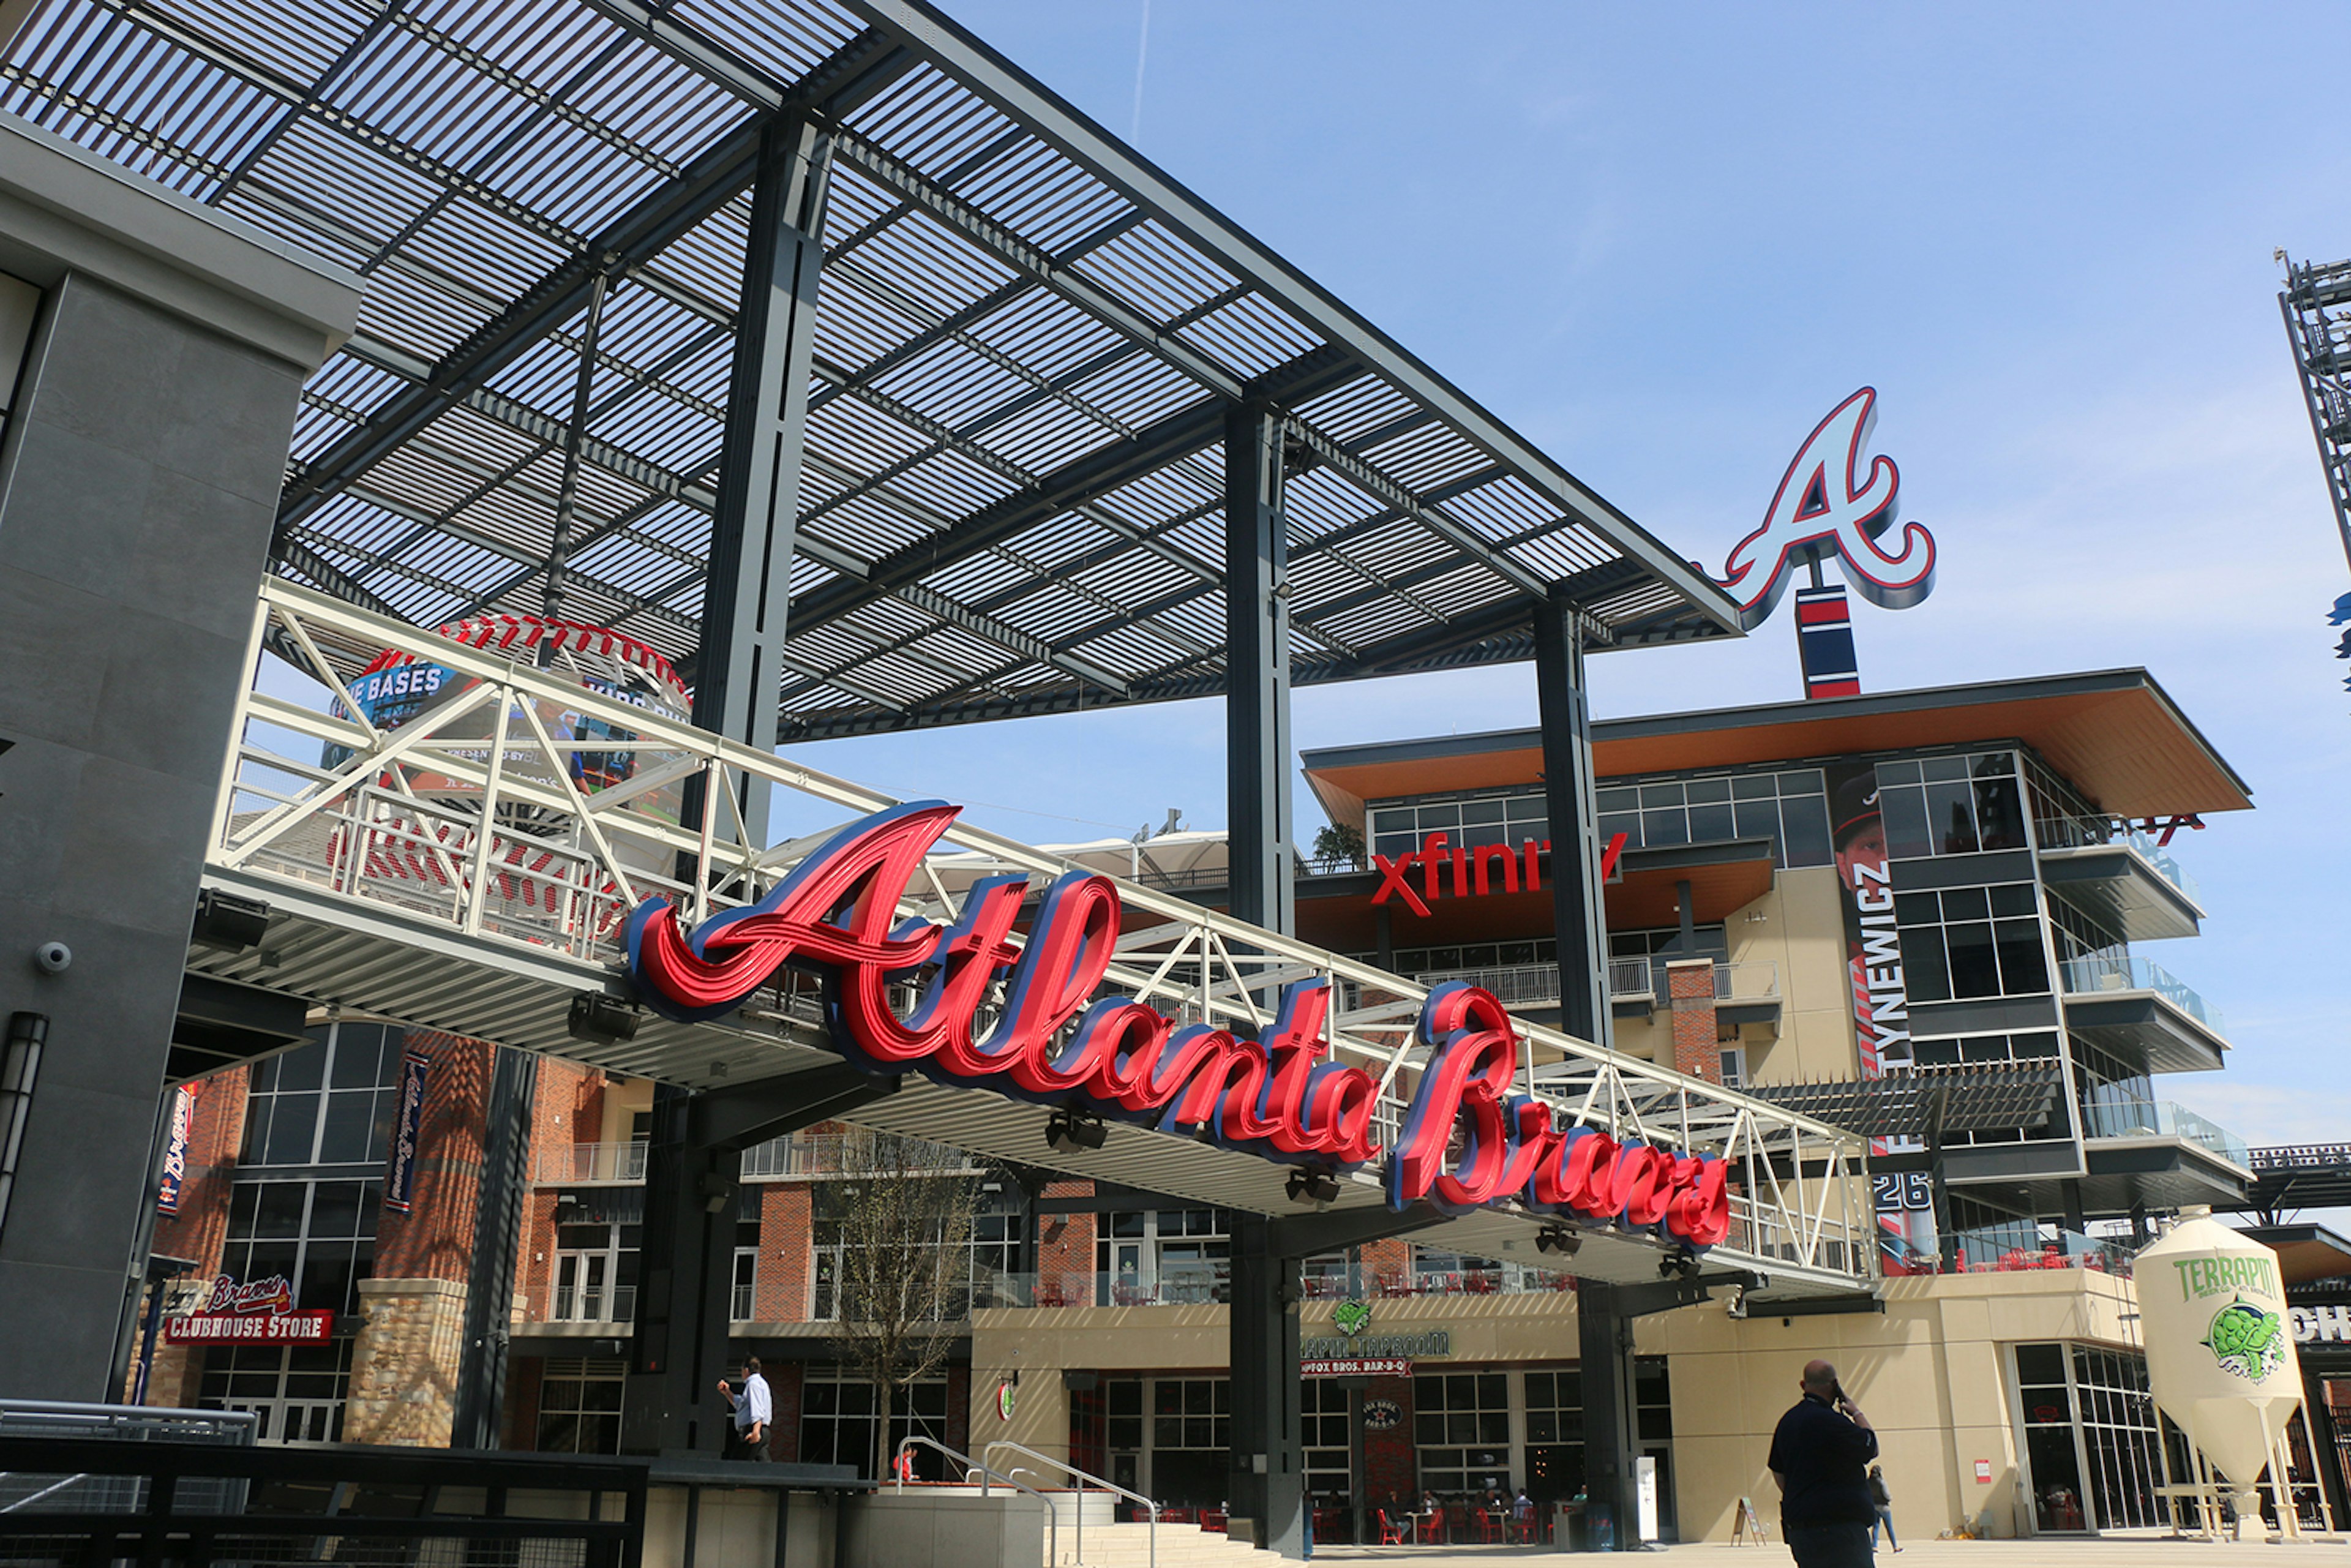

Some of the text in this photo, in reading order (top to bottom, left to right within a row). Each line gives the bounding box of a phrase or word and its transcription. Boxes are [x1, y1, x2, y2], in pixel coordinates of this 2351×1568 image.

[1692, 386, 1937, 612] A
[367, 669, 442, 701] BASES
[1371, 832, 1628, 917] xfini
[621, 800, 1730, 1253] Atlanta Braves
[1853, 860, 1925, 1155] FTYNEWICZ
[164, 1090, 189, 1181] Braves
[1873, 1172, 1931, 1212] 26
[206, 1274, 282, 1313] Braves
[2173, 1257, 2278, 1303] TERRAPIN
[170, 1316, 323, 1338] CLUBHOUSE STORE
[1355, 1332, 1450, 1358] TAPROOM
[1311, 1362, 1330, 1372] FOX
